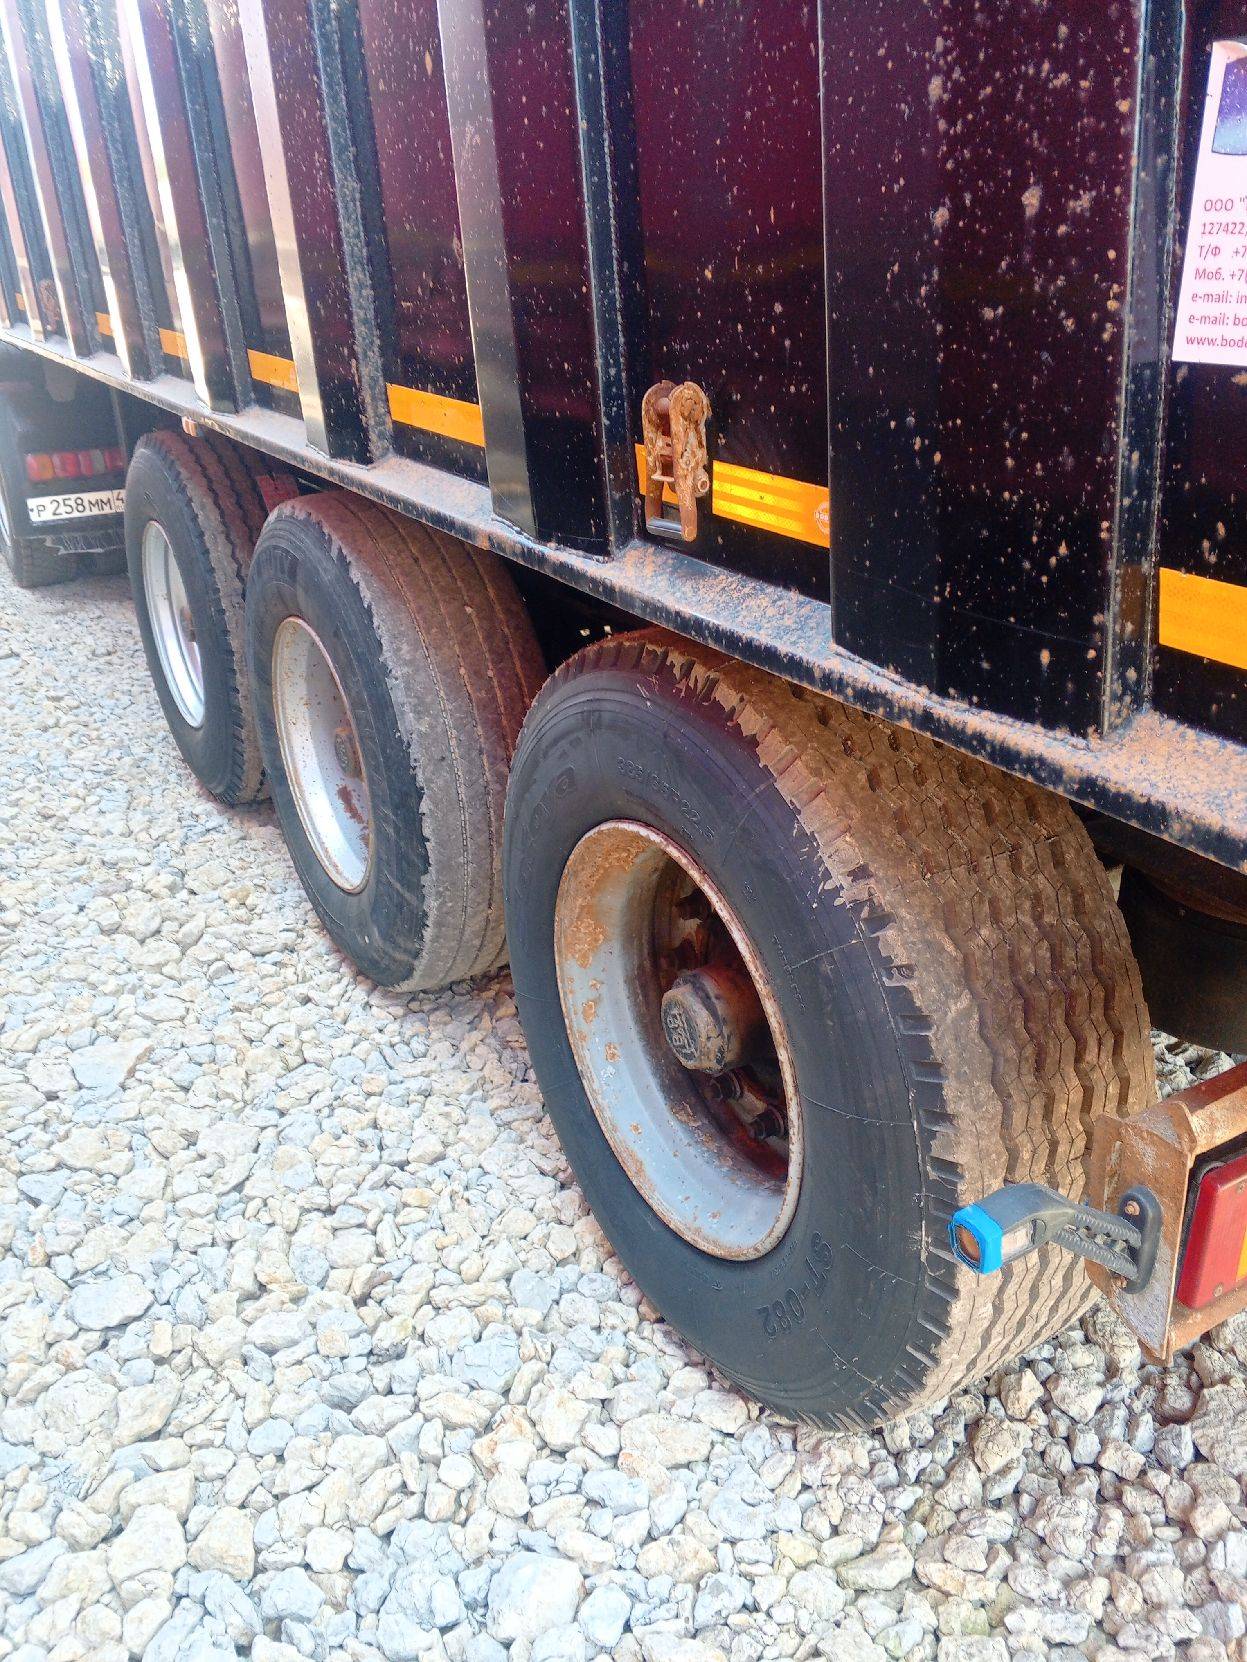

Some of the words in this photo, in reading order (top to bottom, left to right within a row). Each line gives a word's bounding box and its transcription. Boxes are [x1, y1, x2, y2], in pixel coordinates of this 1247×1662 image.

[1204, 198, 1234, 212] ООО
[1198, 243, 1221, 261] Т/Ф
[1194, 267, 1225, 281] Моб.
[1191, 289, 1232, 304] e-mail:
[1188, 312, 1229, 326] e-mail:
